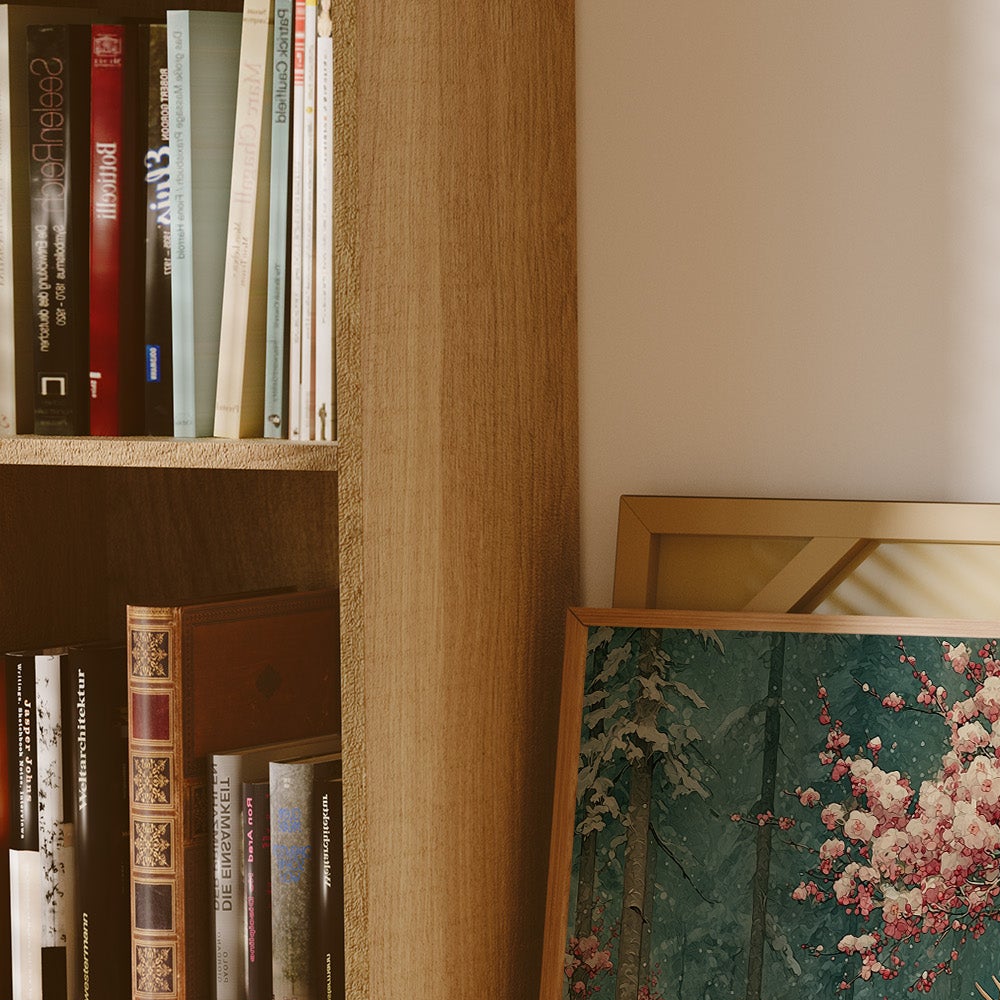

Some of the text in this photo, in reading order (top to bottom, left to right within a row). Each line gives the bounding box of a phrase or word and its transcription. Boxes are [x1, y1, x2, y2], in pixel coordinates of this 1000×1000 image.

[24, 699, 33, 803] Jasper Johns
[77, 668, 87, 811] Weltarchitektur
